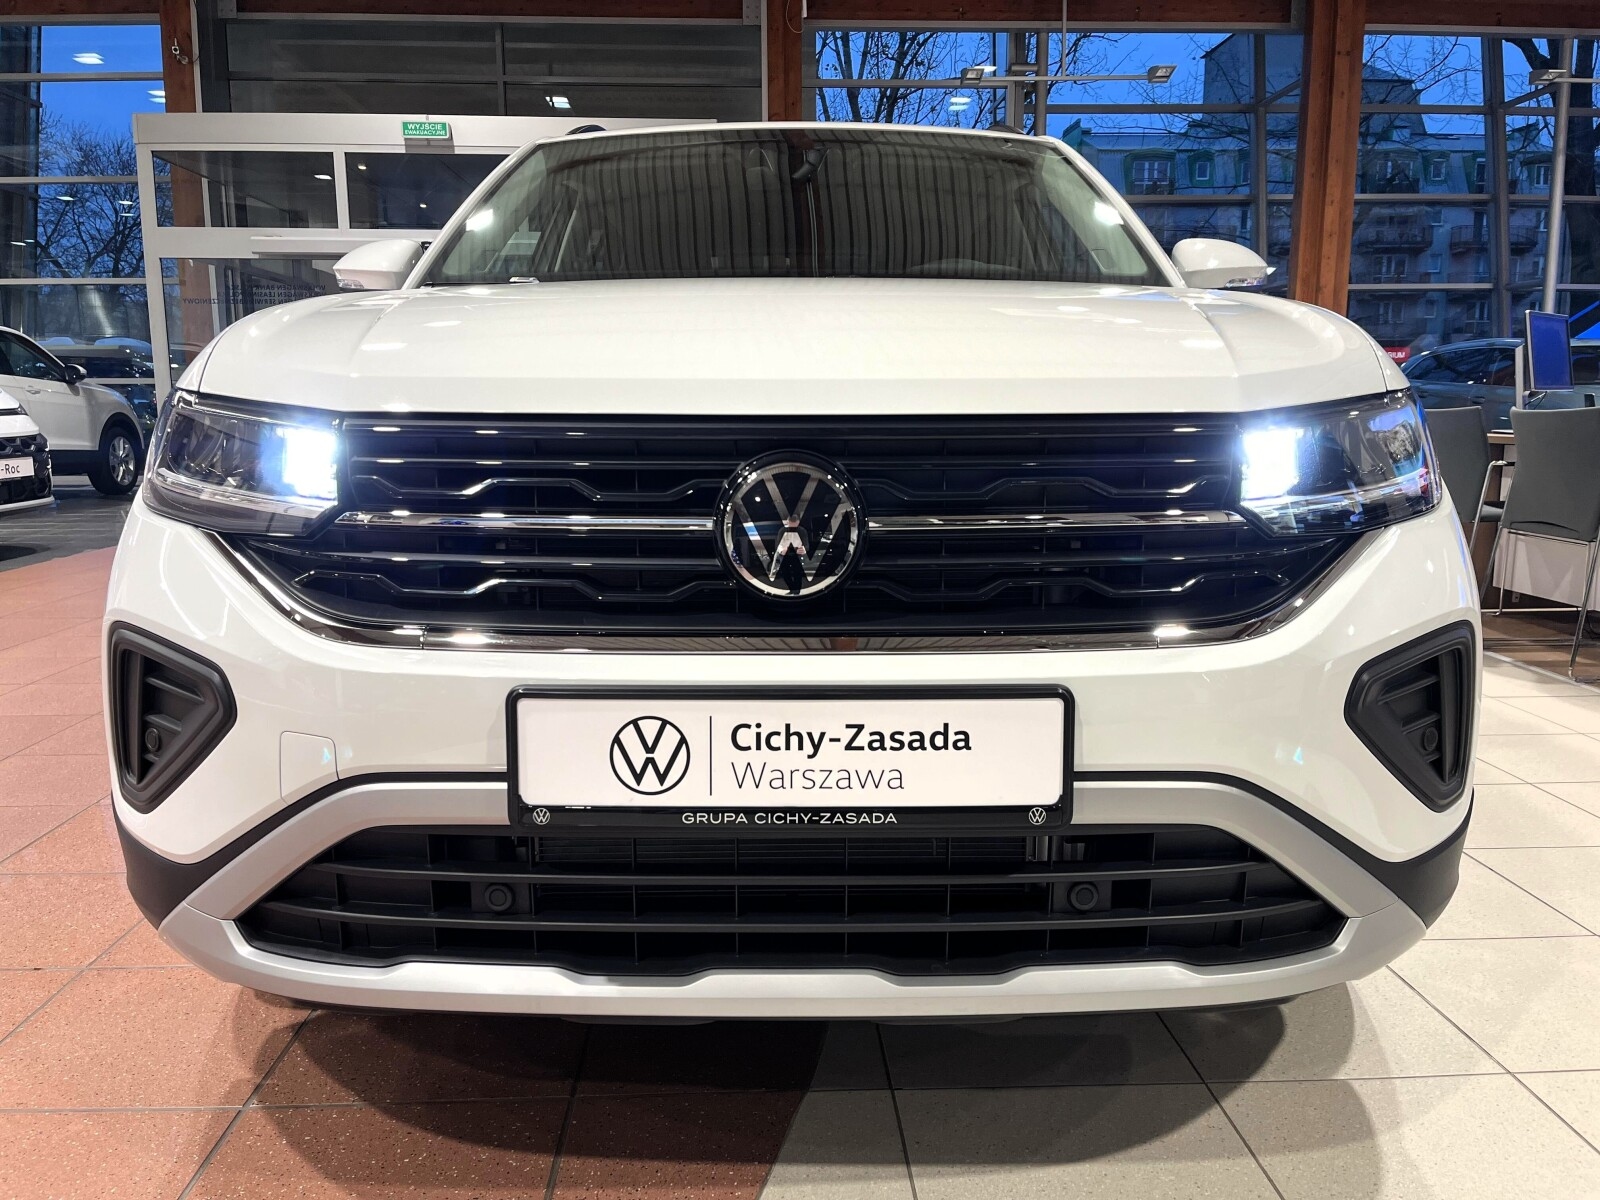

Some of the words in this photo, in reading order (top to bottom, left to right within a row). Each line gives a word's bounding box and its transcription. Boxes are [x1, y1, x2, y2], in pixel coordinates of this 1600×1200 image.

[407, 122, 443, 130] WYJŚCIE
[731, 722, 972, 759] Cichy-Zasada
[610, 715, 691, 796] VW
[731, 762, 904, 790] Warszawa
[682, 812, 748, 824] GRUPA
[754, 812, 898, 824] CICHY-ZASADA
